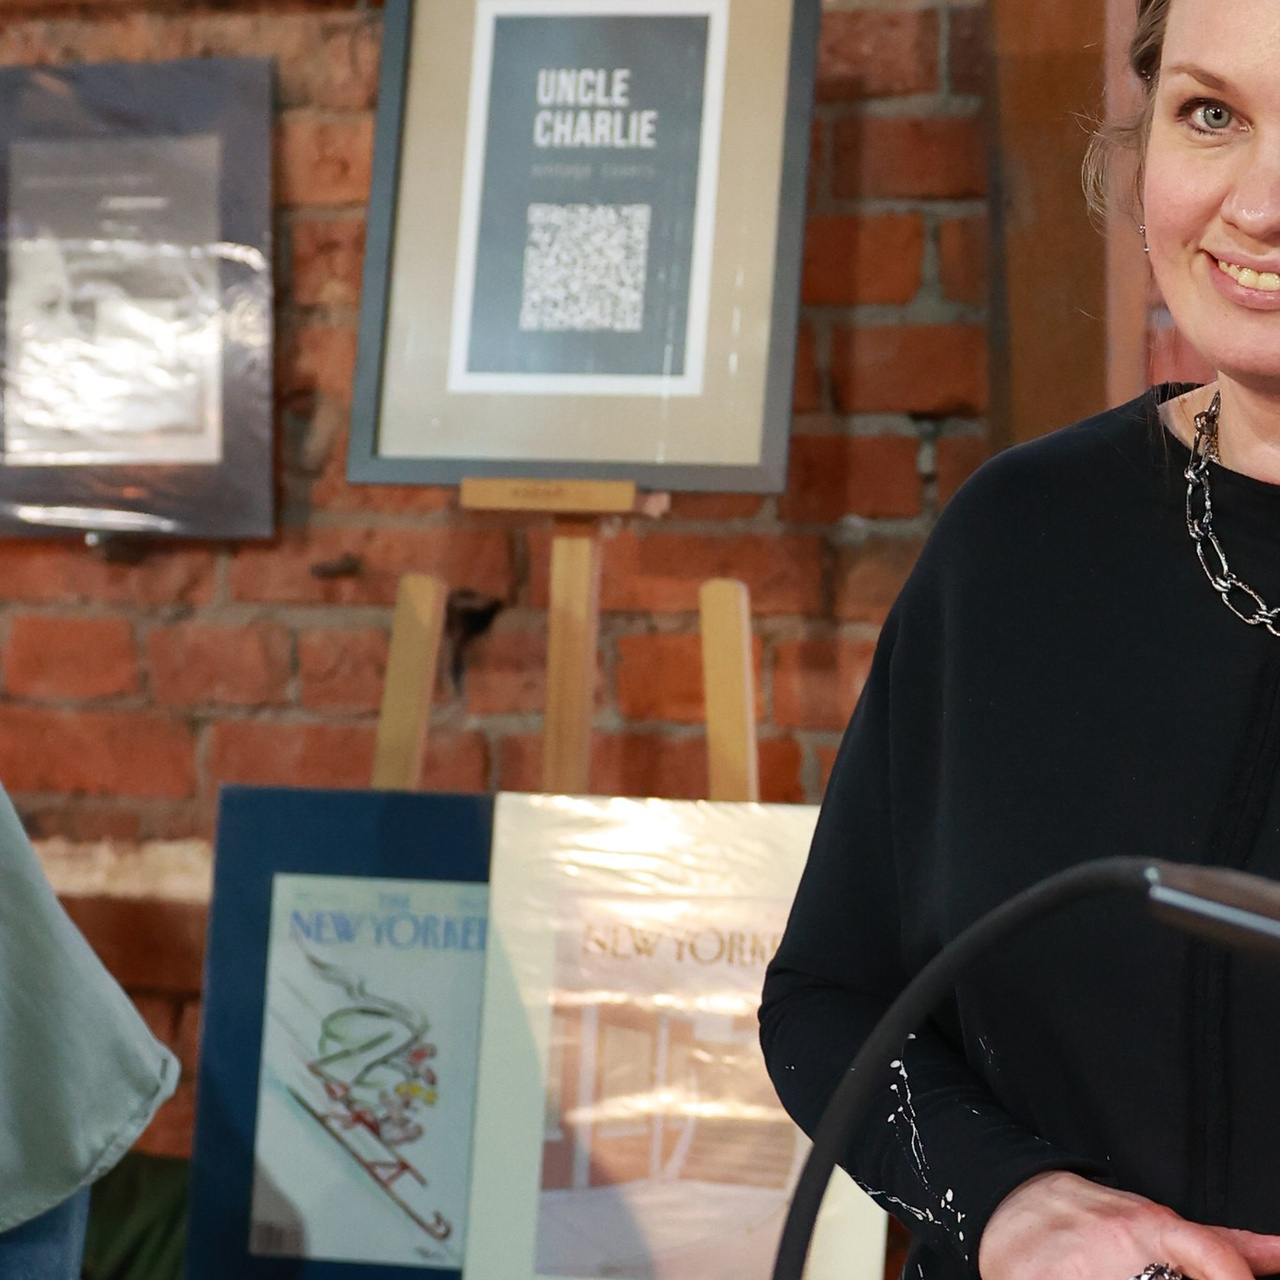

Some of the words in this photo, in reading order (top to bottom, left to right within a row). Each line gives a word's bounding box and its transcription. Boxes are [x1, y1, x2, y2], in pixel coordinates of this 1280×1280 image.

[536, 68, 631, 107] UNCLE
[533, 108, 659, 149] CHARLIE
[288, 908, 362, 946] NEW
[582, 923, 662, 960] NEW
